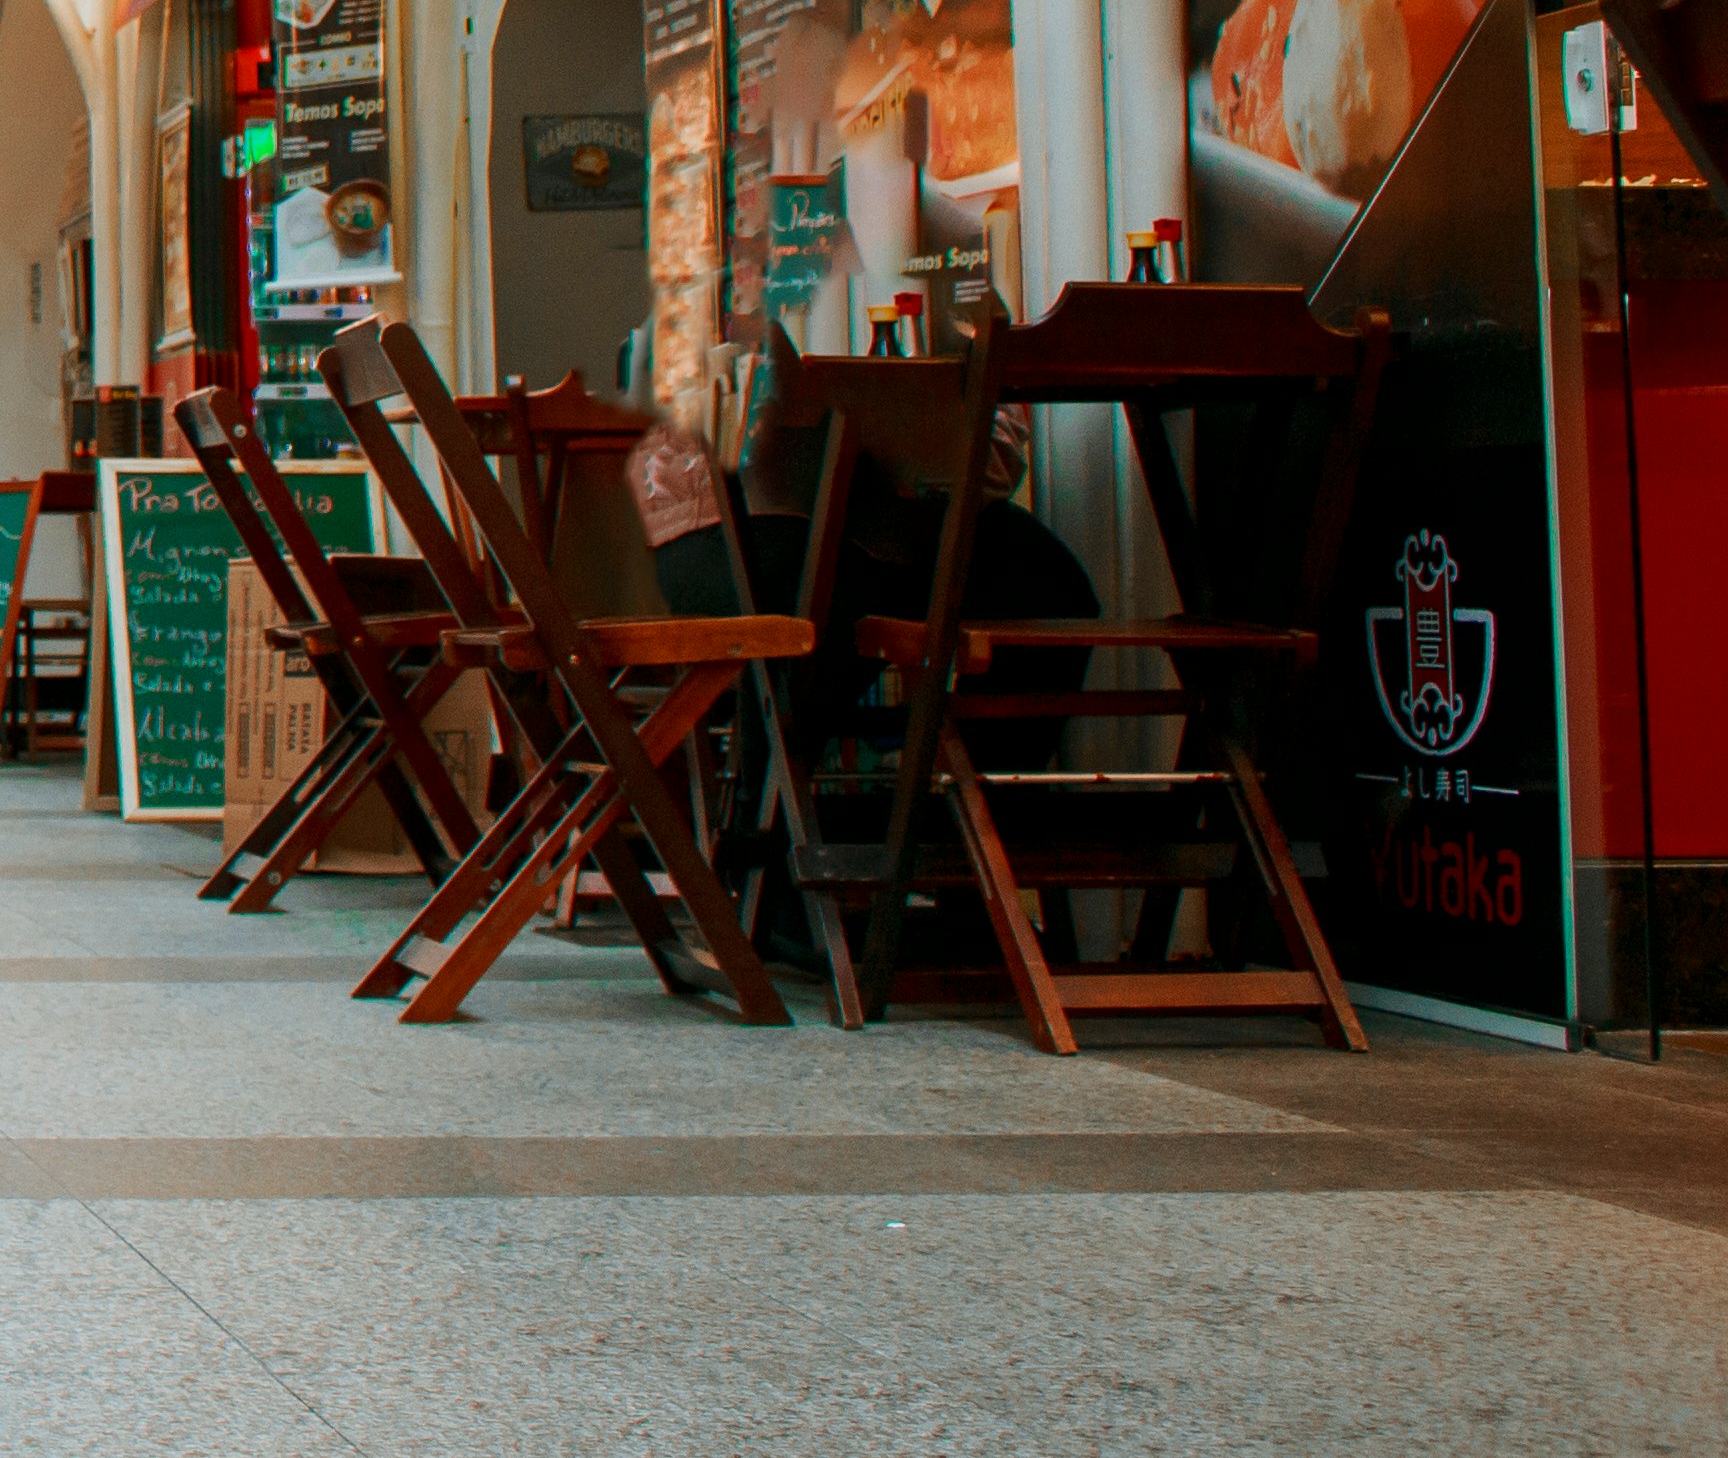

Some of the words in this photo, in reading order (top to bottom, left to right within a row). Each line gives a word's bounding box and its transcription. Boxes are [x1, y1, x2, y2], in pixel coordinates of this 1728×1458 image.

[285, 102, 340, 125] Temos
[343, 95, 386, 120] Sopa
[1365, 818, 1524, 927] Yutaka
